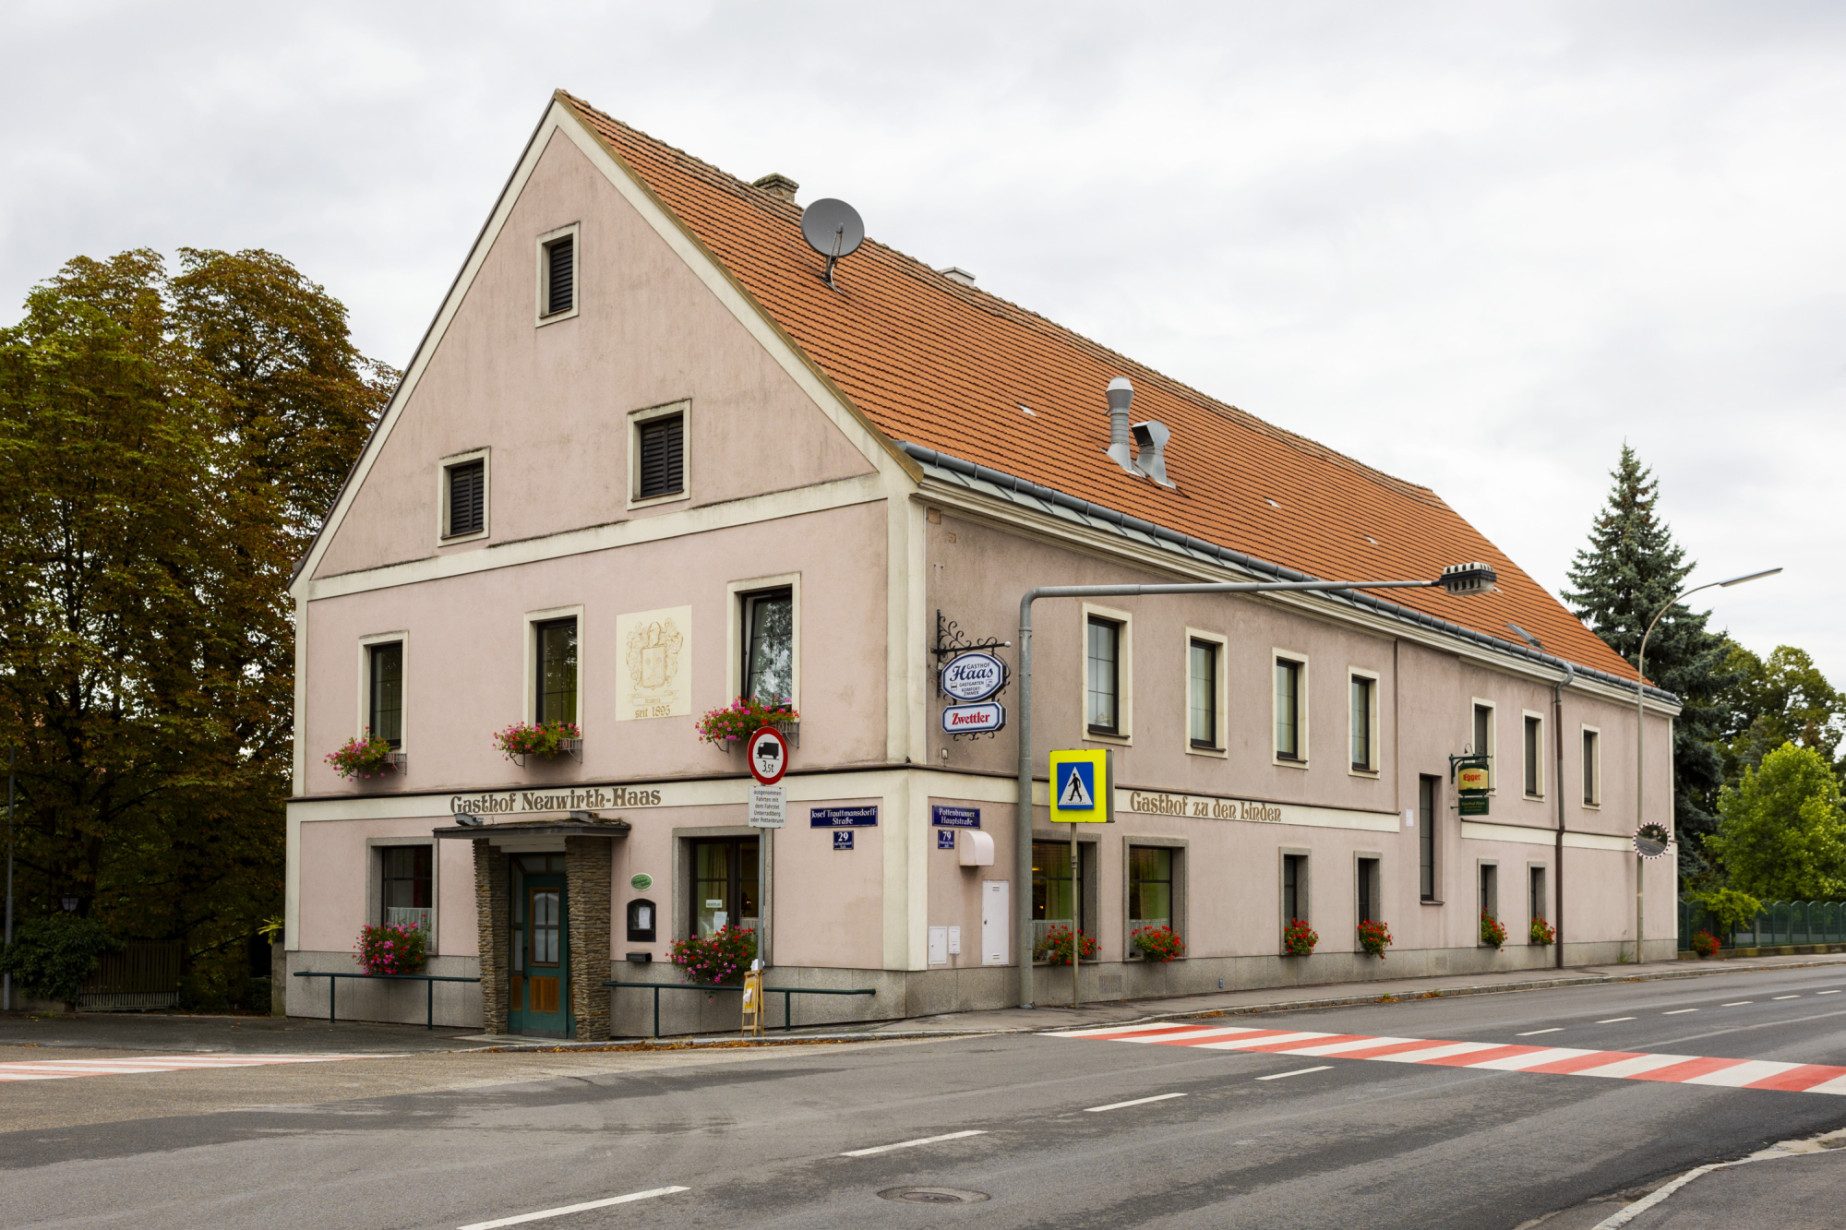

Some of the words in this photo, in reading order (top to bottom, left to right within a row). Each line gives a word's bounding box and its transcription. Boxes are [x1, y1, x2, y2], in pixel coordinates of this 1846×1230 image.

[950, 664, 993, 681] Haas
[952, 712, 990, 725] Zwettler
[762, 760, 774, 773] 3,5t
[1463, 773, 1481, 782] Egger
[450, 792, 516, 814] Gasthof
[521, 787, 661, 811] Neuwirth-Haas
[1130, 791, 1188, 816] Gasthof
[1193, 801, 1209, 817] zu
[1213, 799, 1236, 820] den
[1240, 801, 1281, 822] Linden
[811, 810, 826, 818] Josef
[939, 808, 975, 818] Pottenbrunner
[832, 817, 854, 825] Straße
[941, 816, 973, 826] Hauptstraße
[838, 832, 849, 842] 29
[942, 831, 952, 841] 79
